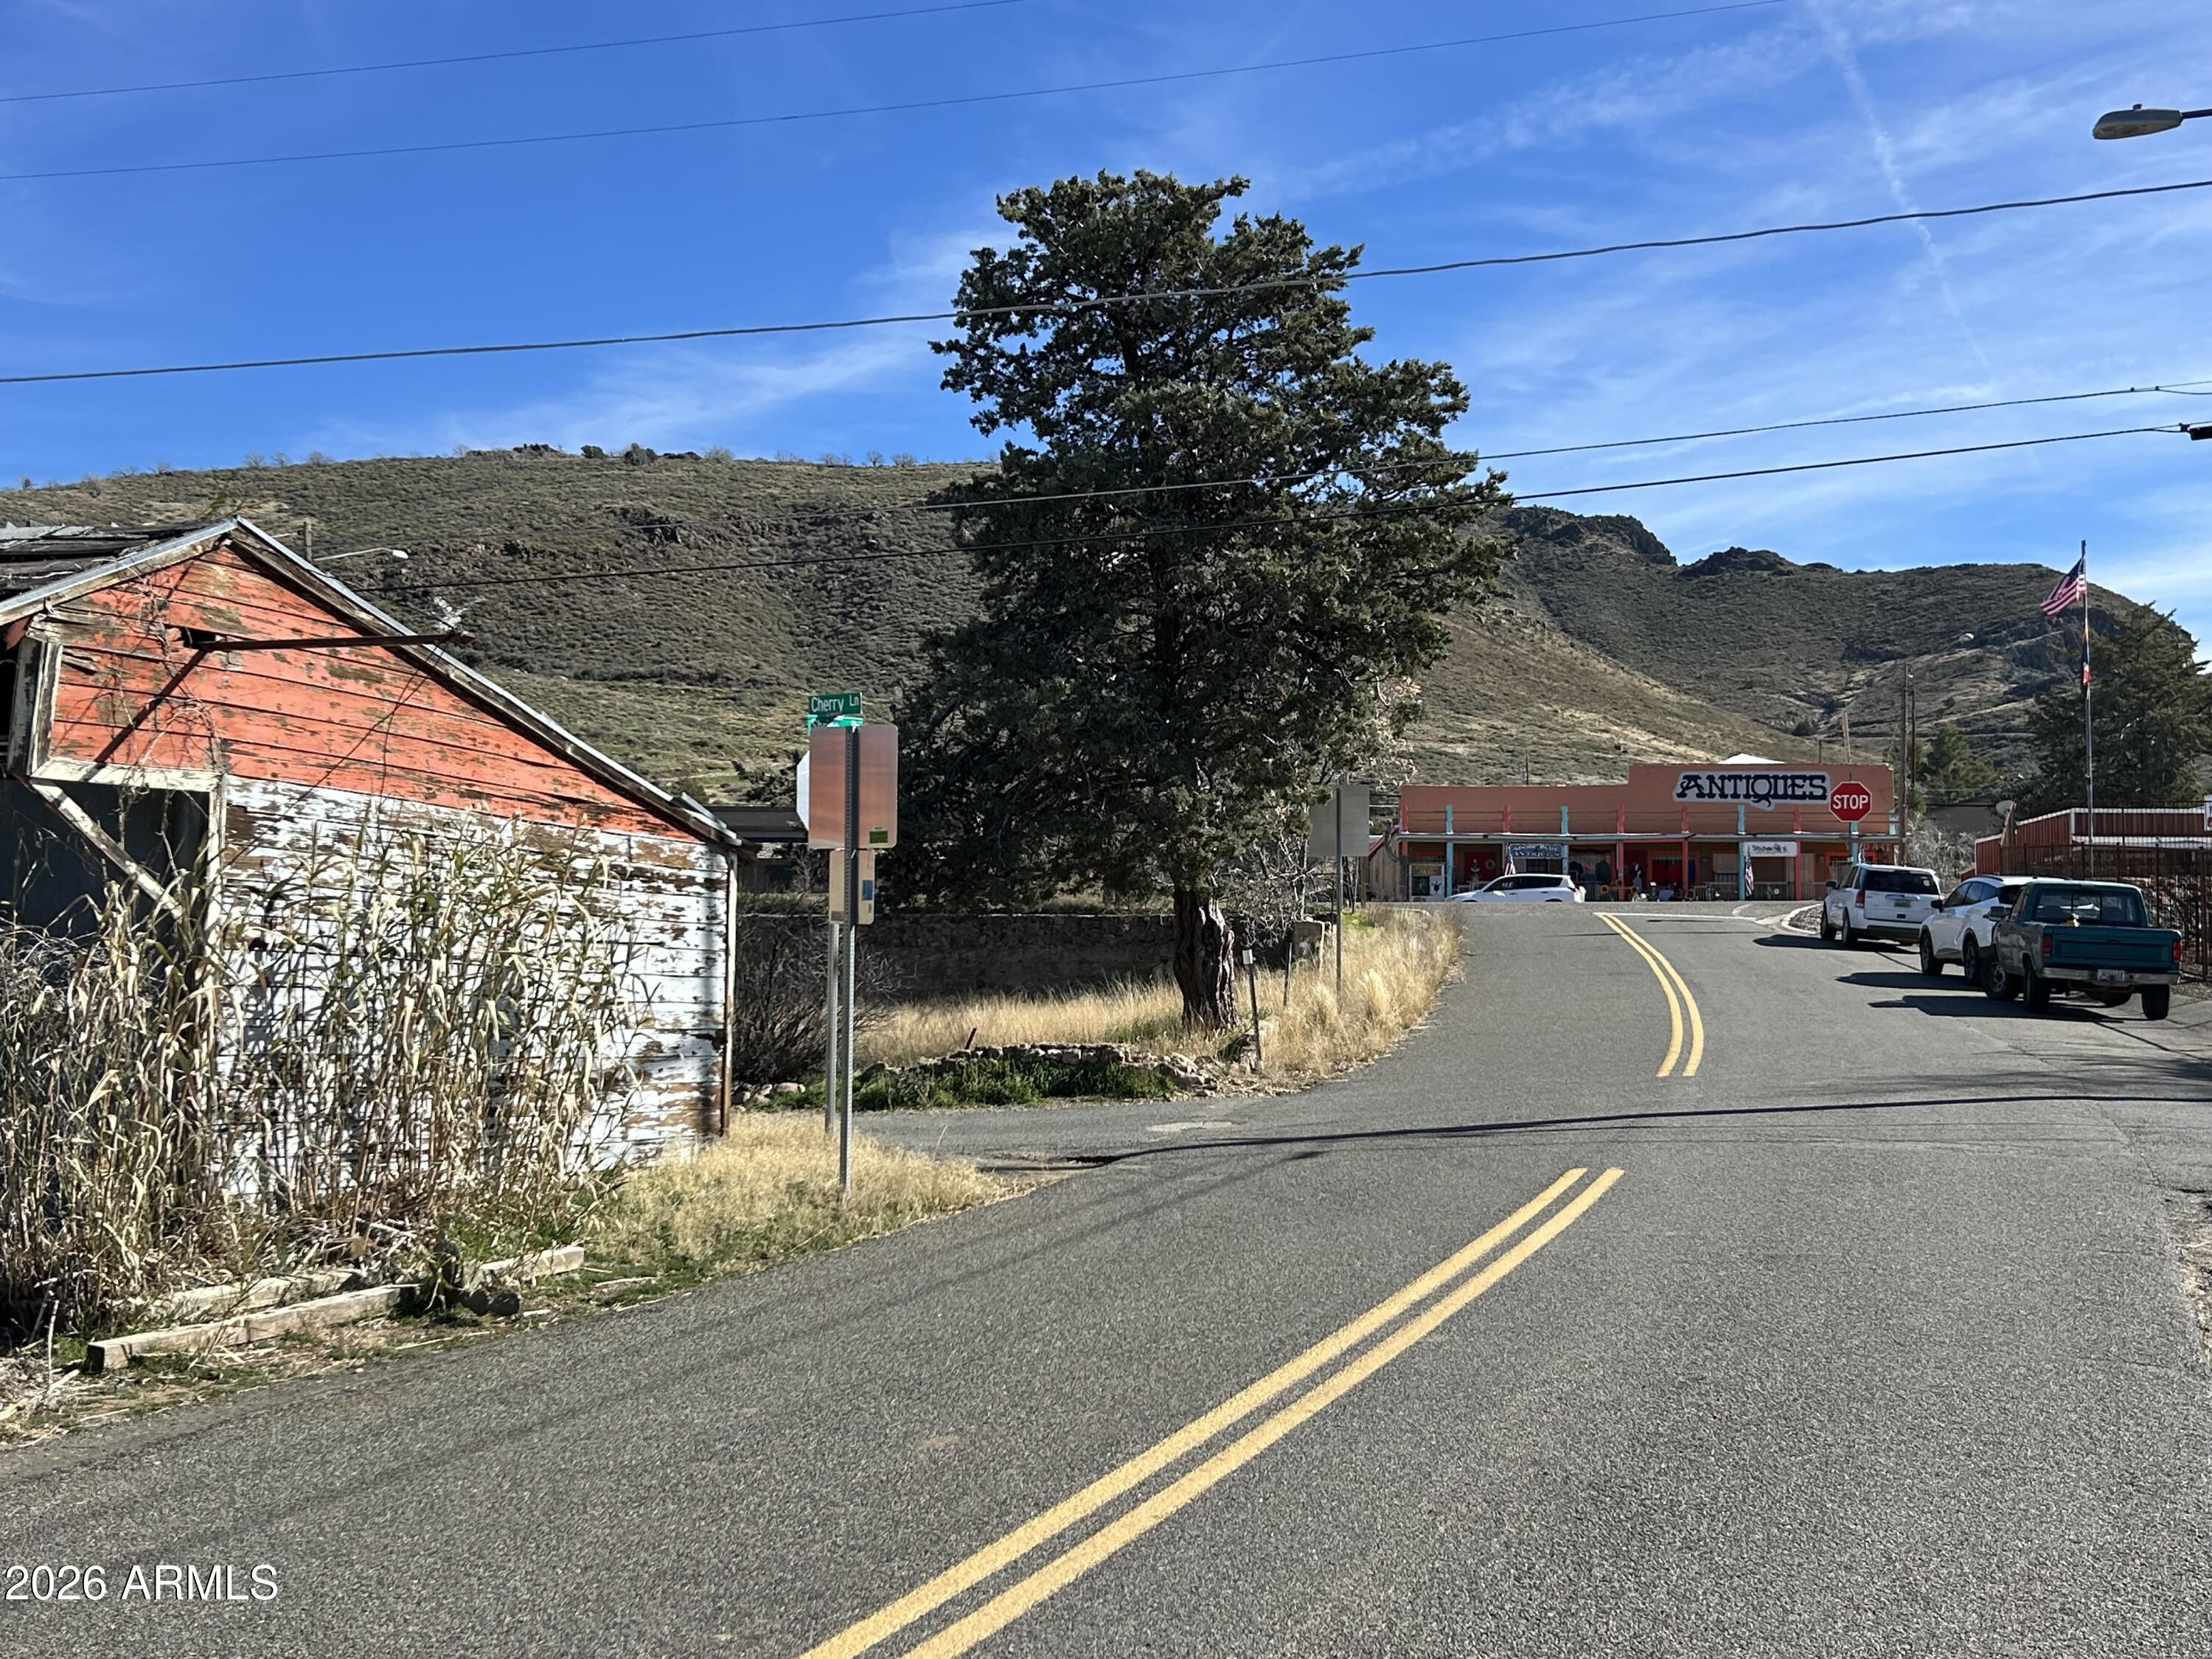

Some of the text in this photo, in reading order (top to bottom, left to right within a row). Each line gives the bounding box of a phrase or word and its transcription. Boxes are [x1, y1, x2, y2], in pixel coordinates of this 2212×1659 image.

[811, 695, 860, 713] Cherry Ln
[1676, 774, 1827, 807] ANTIQUES
[1832, 794, 1868, 810] STOP
